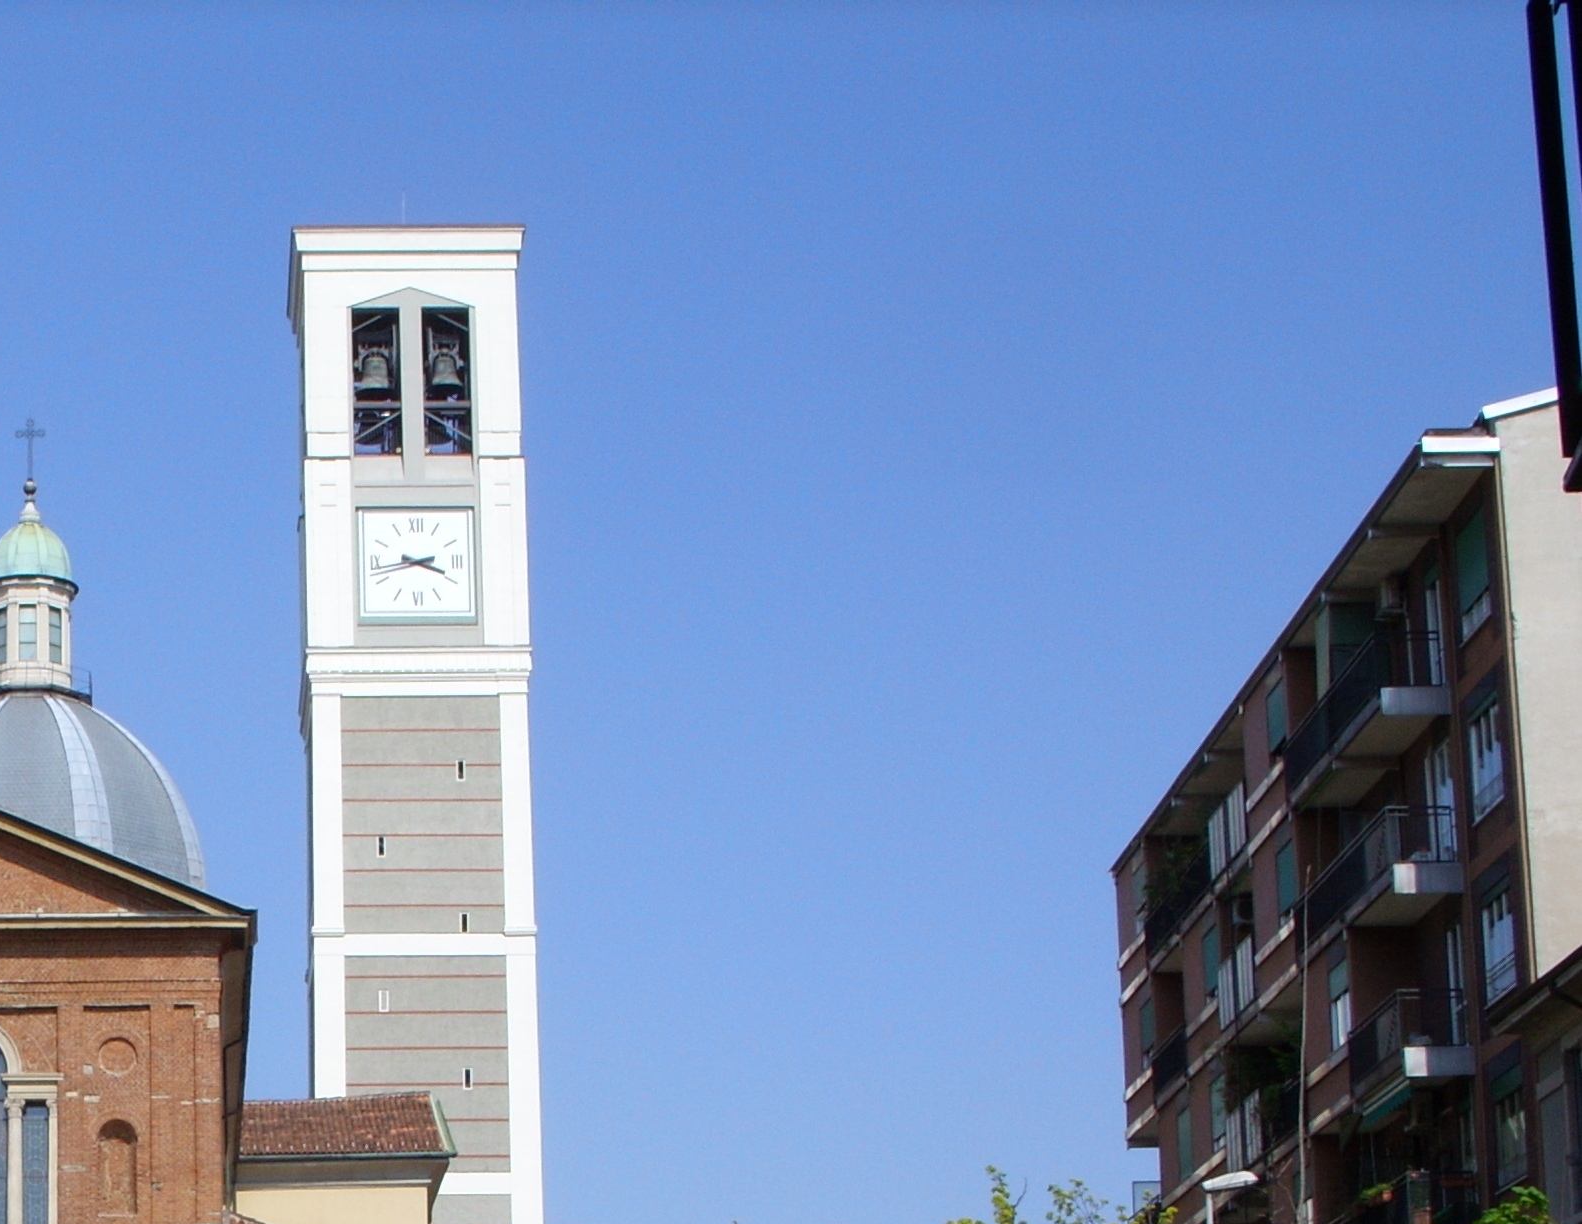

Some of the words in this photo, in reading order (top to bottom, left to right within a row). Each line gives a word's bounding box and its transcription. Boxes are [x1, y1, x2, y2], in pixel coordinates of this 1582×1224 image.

[408, 517, 424, 533] XII
[370, 554, 381, 570] IX
[451, 554, 463, 570] III
[412, 591, 424, 607] VI
